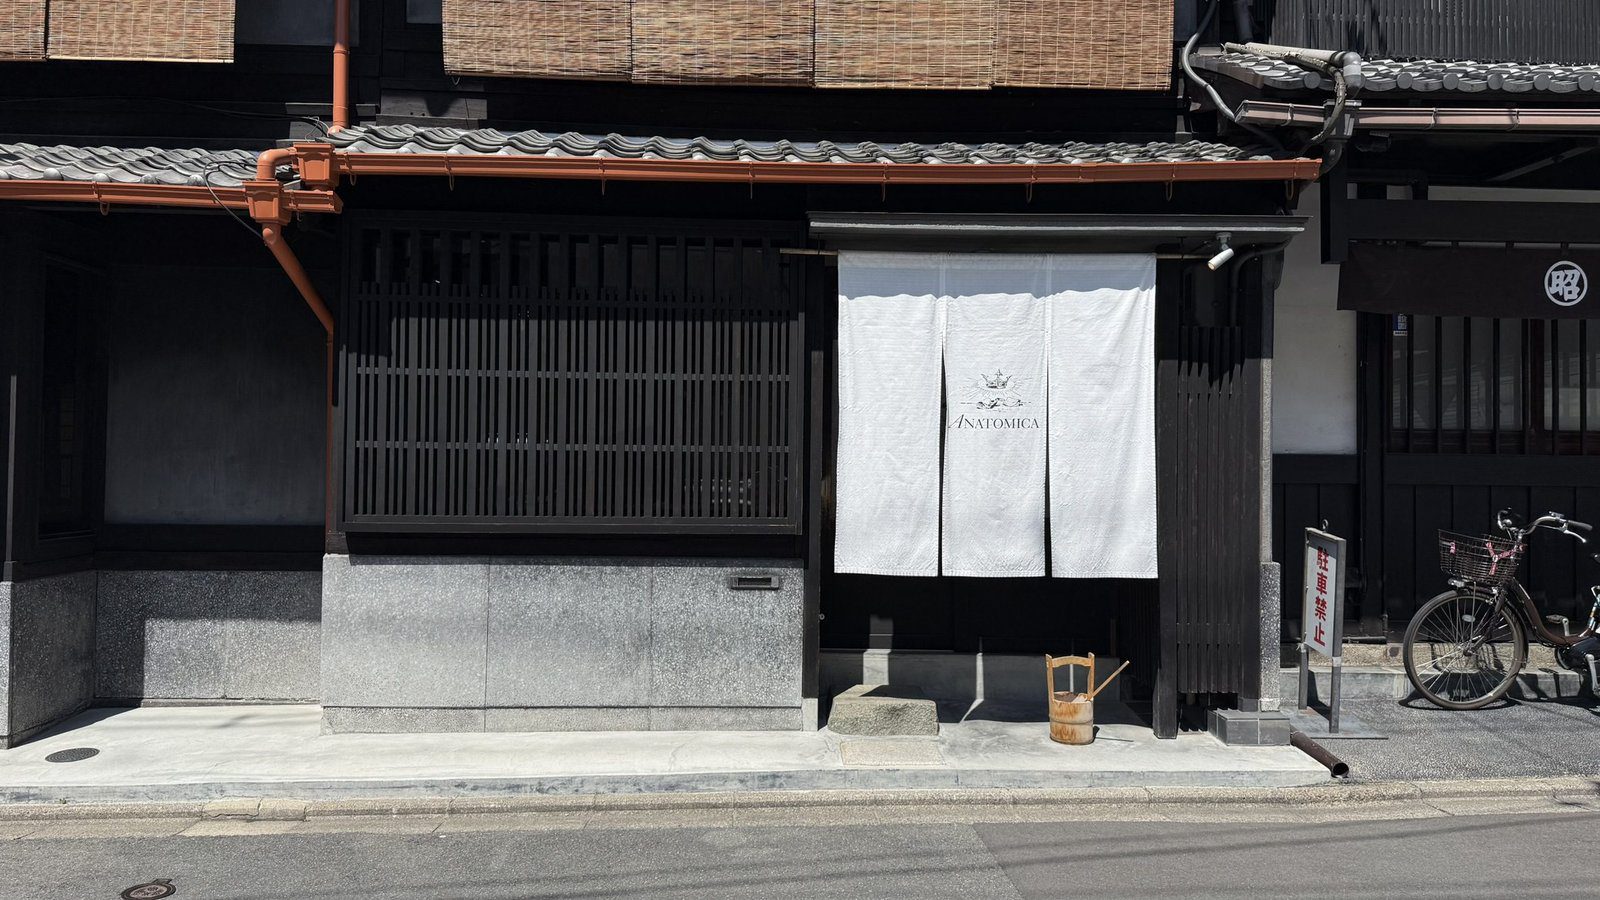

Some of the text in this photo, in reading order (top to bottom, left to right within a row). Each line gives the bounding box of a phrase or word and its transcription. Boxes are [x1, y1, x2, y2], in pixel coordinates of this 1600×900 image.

[1548, 268, 1581, 302] 昭
[948, 414, 1039, 429] ANATOMICA
[1313, 545, 1329, 647] 駐車禁止
